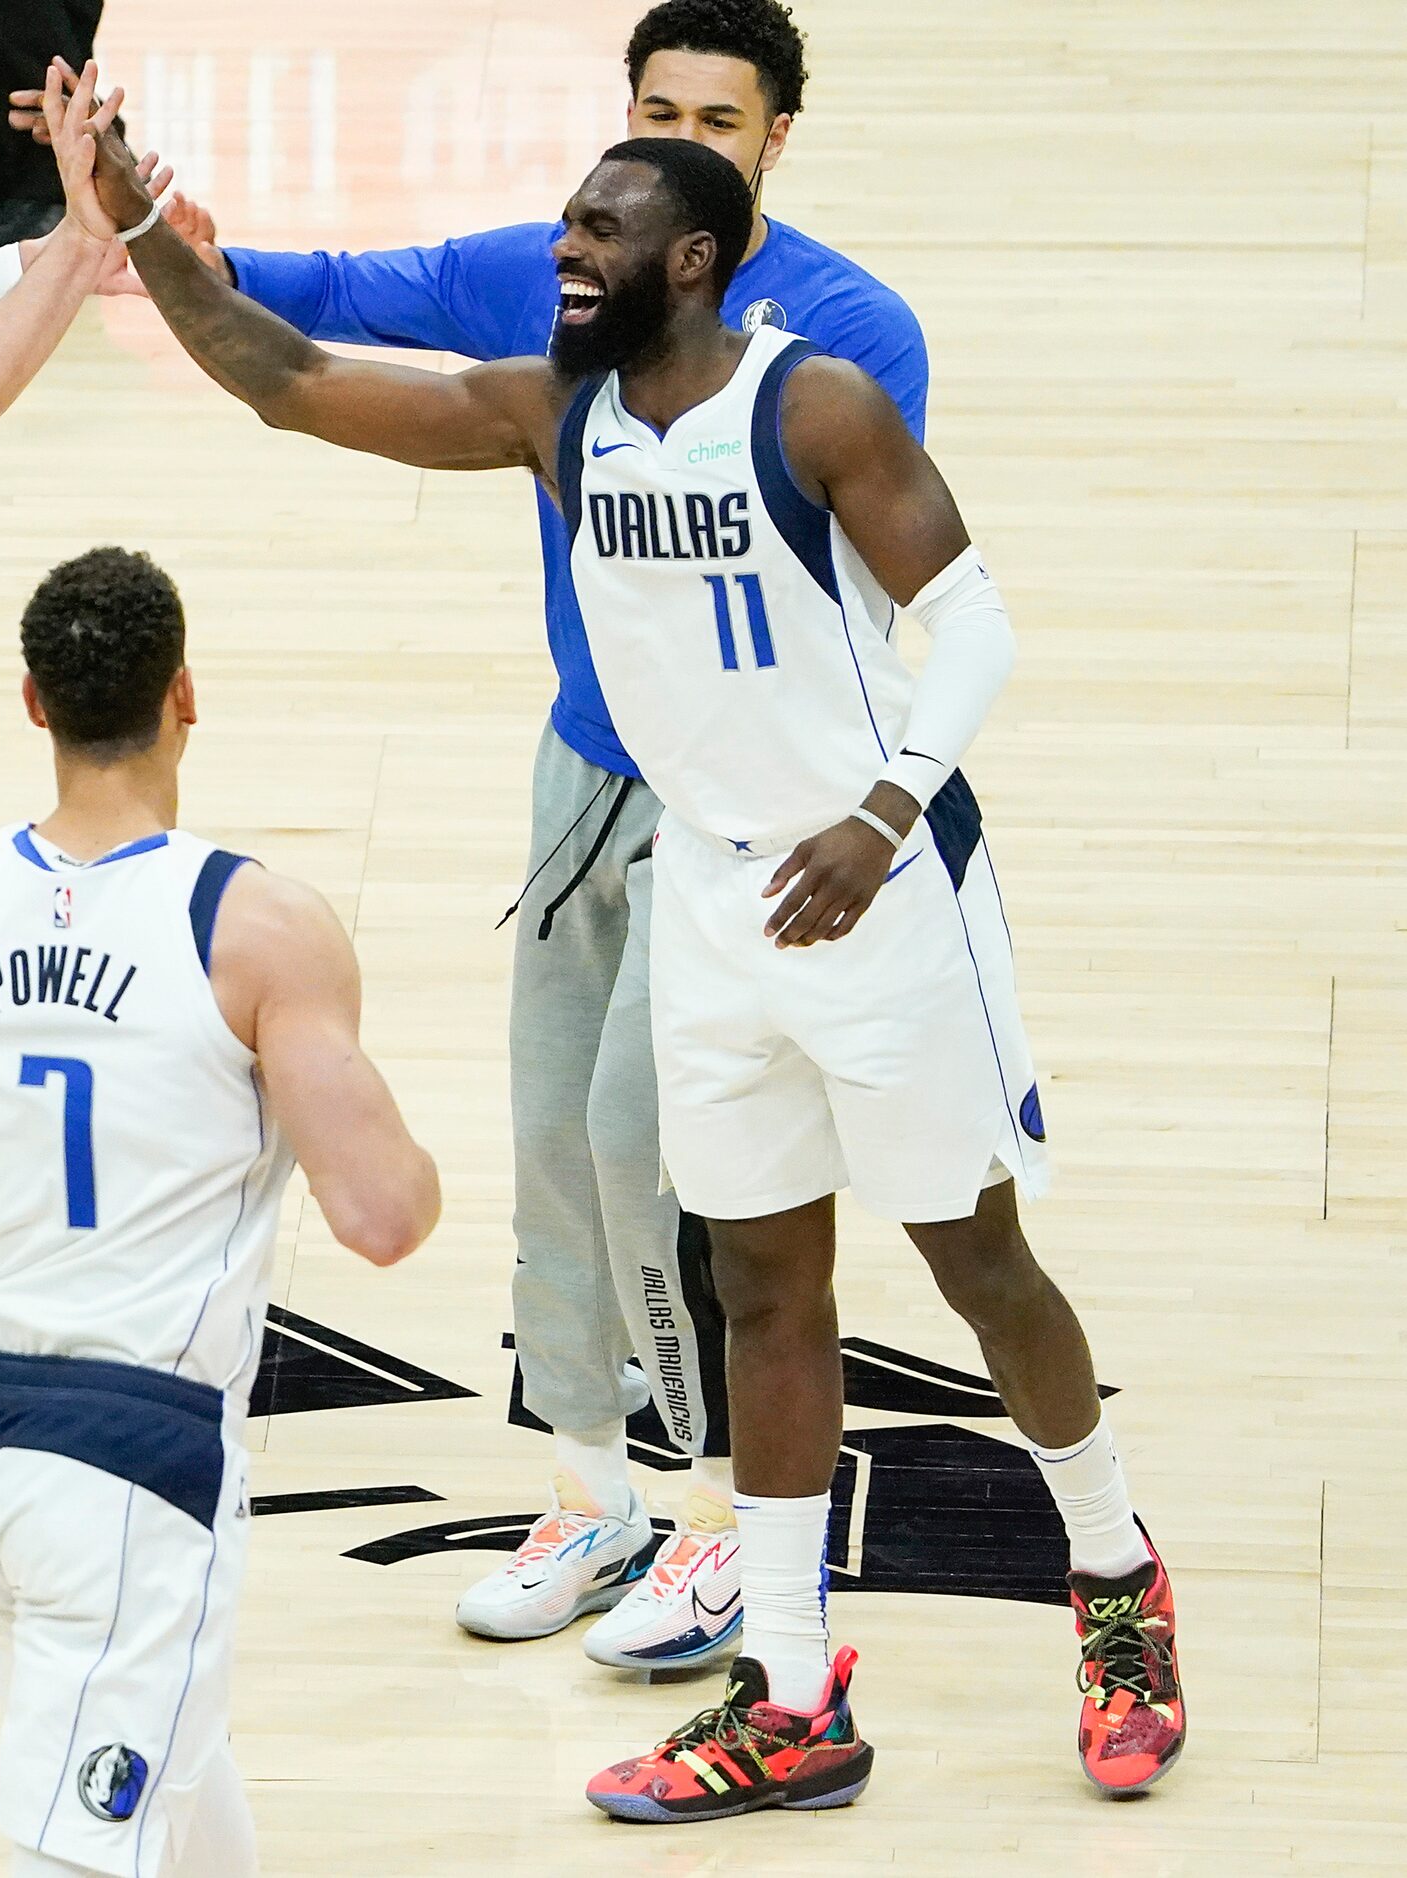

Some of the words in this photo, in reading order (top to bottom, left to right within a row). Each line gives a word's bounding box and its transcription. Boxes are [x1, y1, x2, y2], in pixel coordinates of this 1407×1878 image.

[687, 438, 742, 464] chime
[587, 488, 754, 562] DALLAS
[699, 572, 779, 673] 11
[18, 1053, 98, 1230] 7
[641, 1265, 676, 1331] DALLAS
[654, 1335, 693, 1442] MAVERICKS
